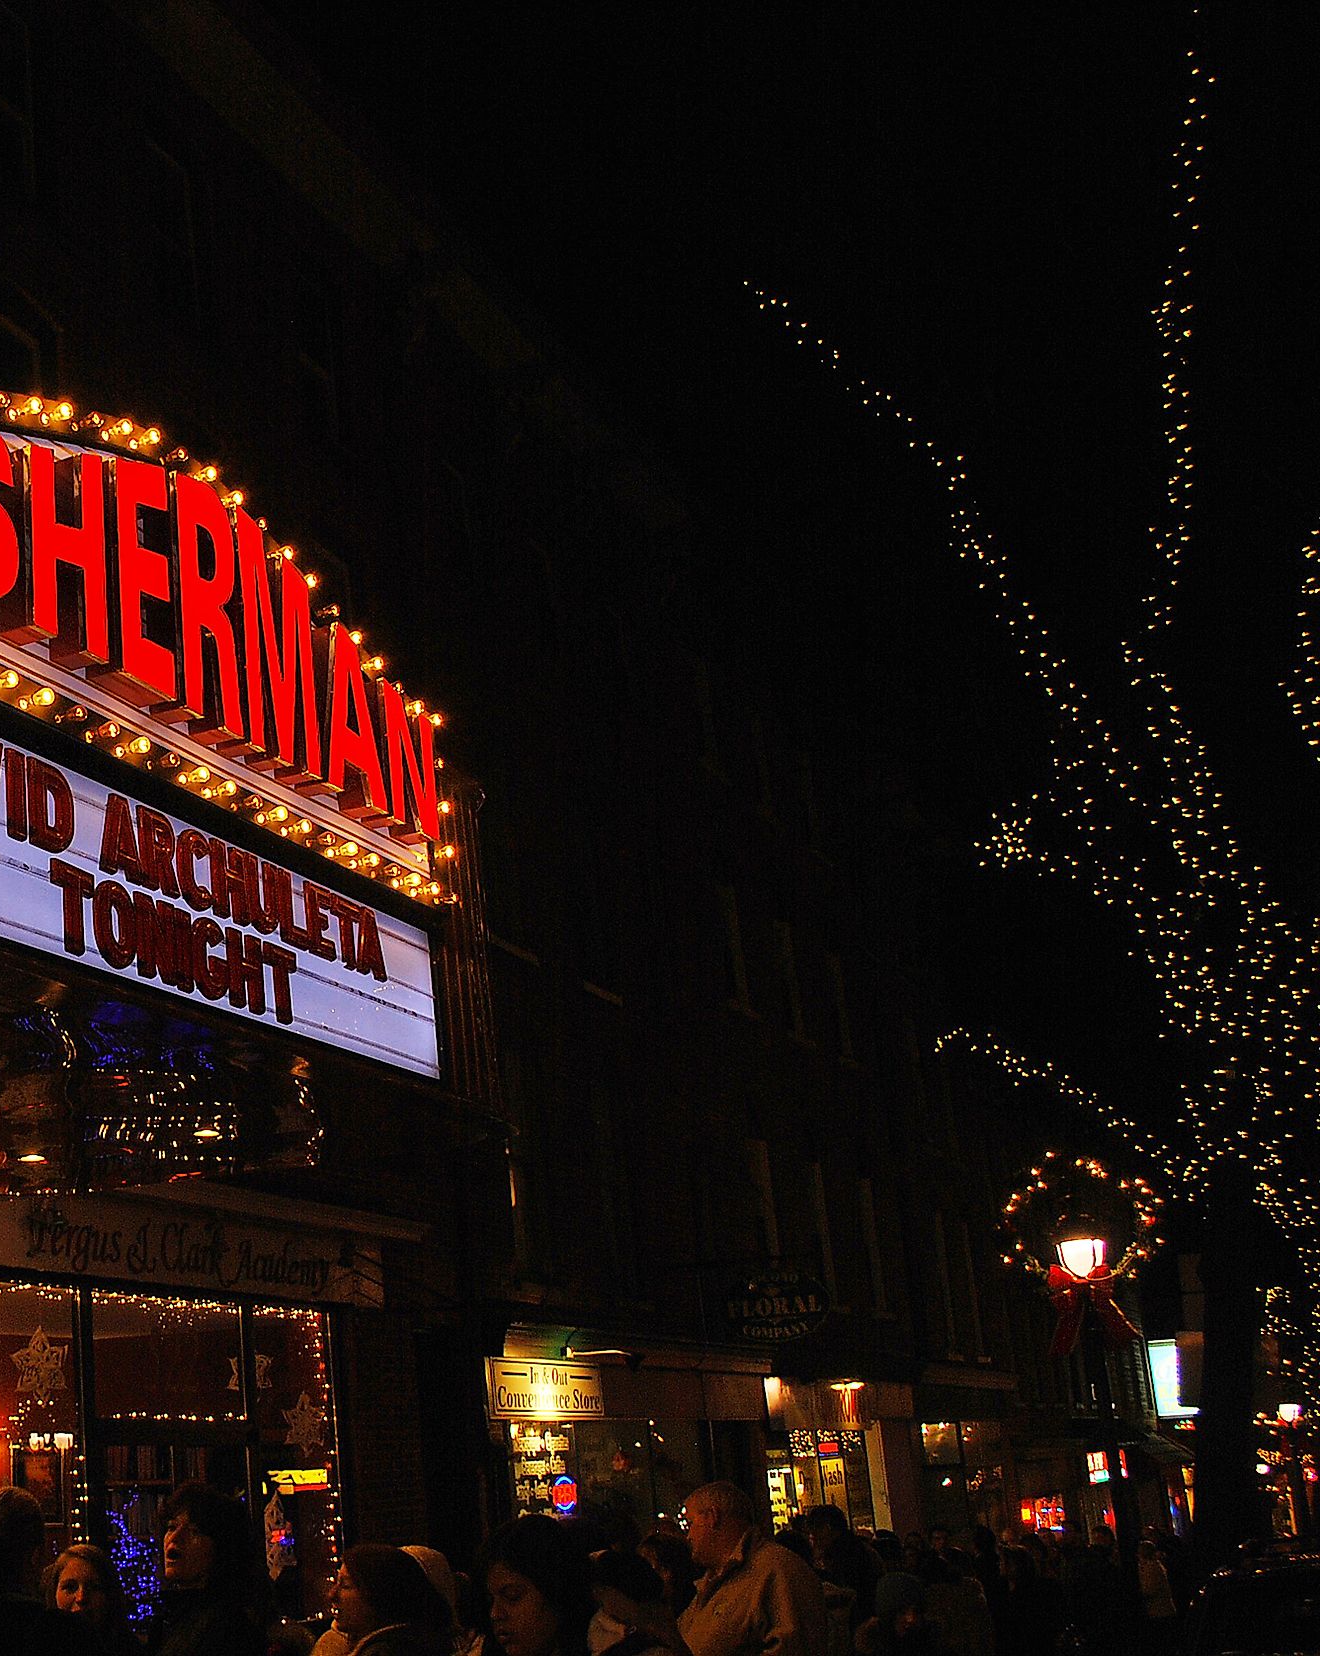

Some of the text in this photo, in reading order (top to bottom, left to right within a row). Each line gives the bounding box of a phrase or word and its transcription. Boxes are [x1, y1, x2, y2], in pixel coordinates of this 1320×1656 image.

[98, 792, 389, 983] ARCHULETA
[47, 857, 298, 1026] TONIGHT
[26, 1218, 122, 1272] Fergus
[218, 1238, 331, 1296] Academy
[727, 1294, 822, 1318] FLORAL
[529, 1366, 540, 1385] In
[551, 1367, 568, 1386] Out
[572, 1388, 600, 1410] Store
